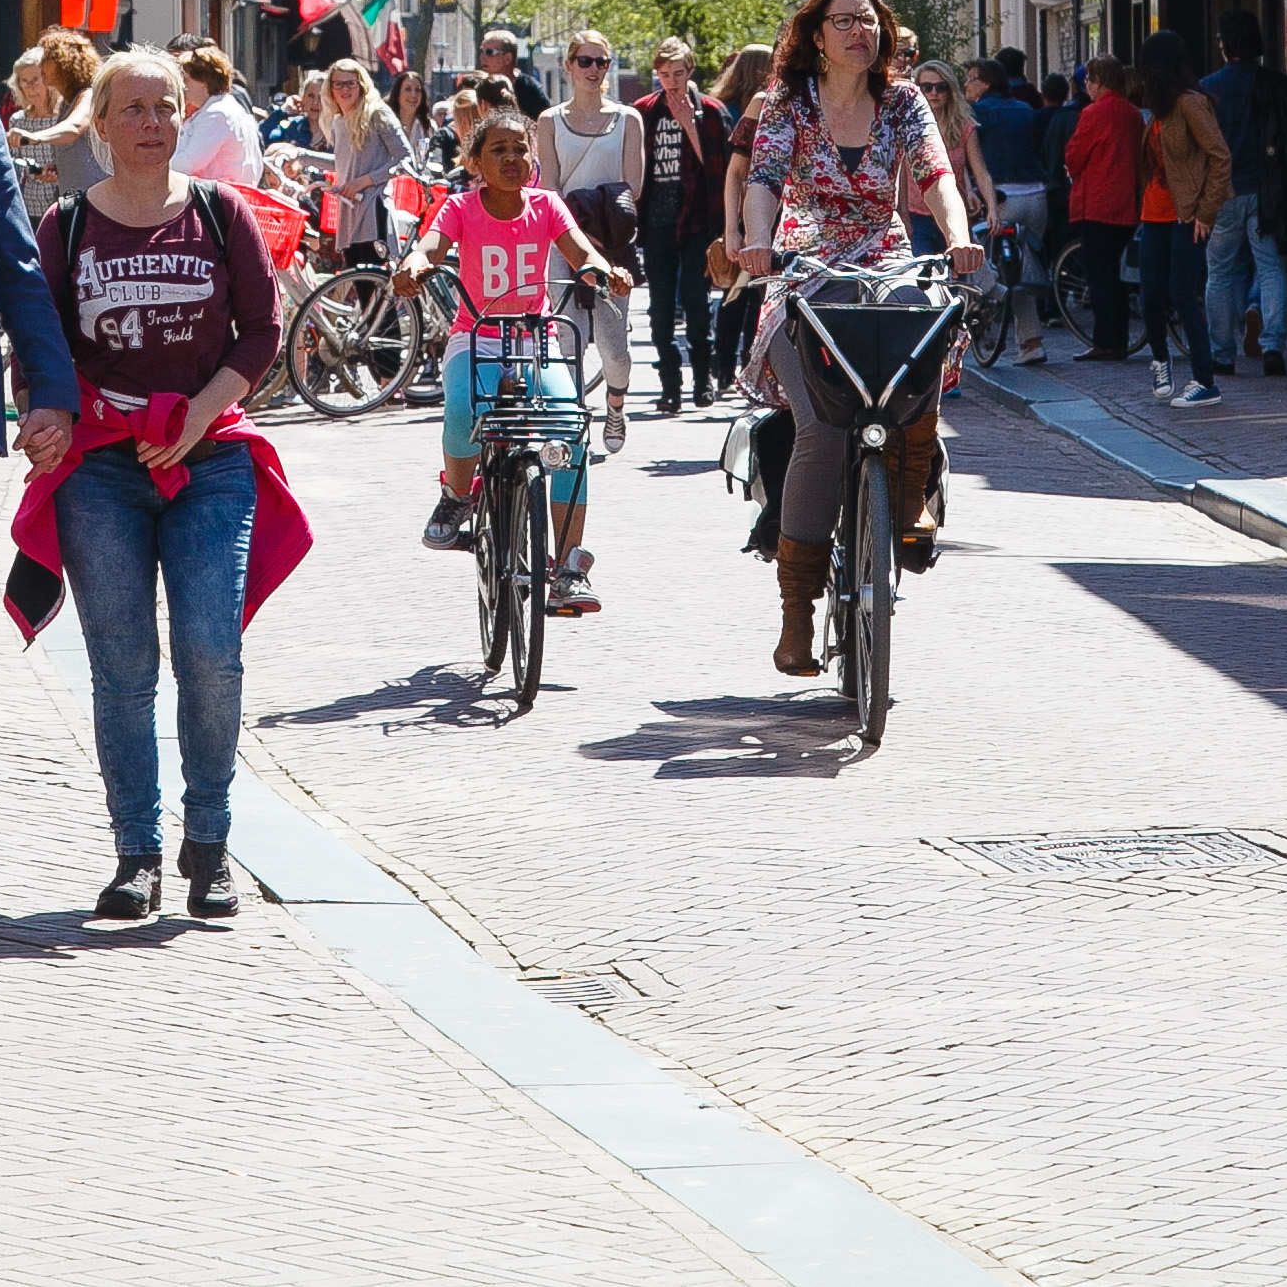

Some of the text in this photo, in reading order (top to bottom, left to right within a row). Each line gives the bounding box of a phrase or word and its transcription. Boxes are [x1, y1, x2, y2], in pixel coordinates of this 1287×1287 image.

[77, 246, 215, 301] AUTHENTIC
[481, 243, 539, 298] BE
[109, 284, 161, 303] CLUB
[100, 306, 204, 351] 94 Track and
[163, 326, 194, 345] Field
